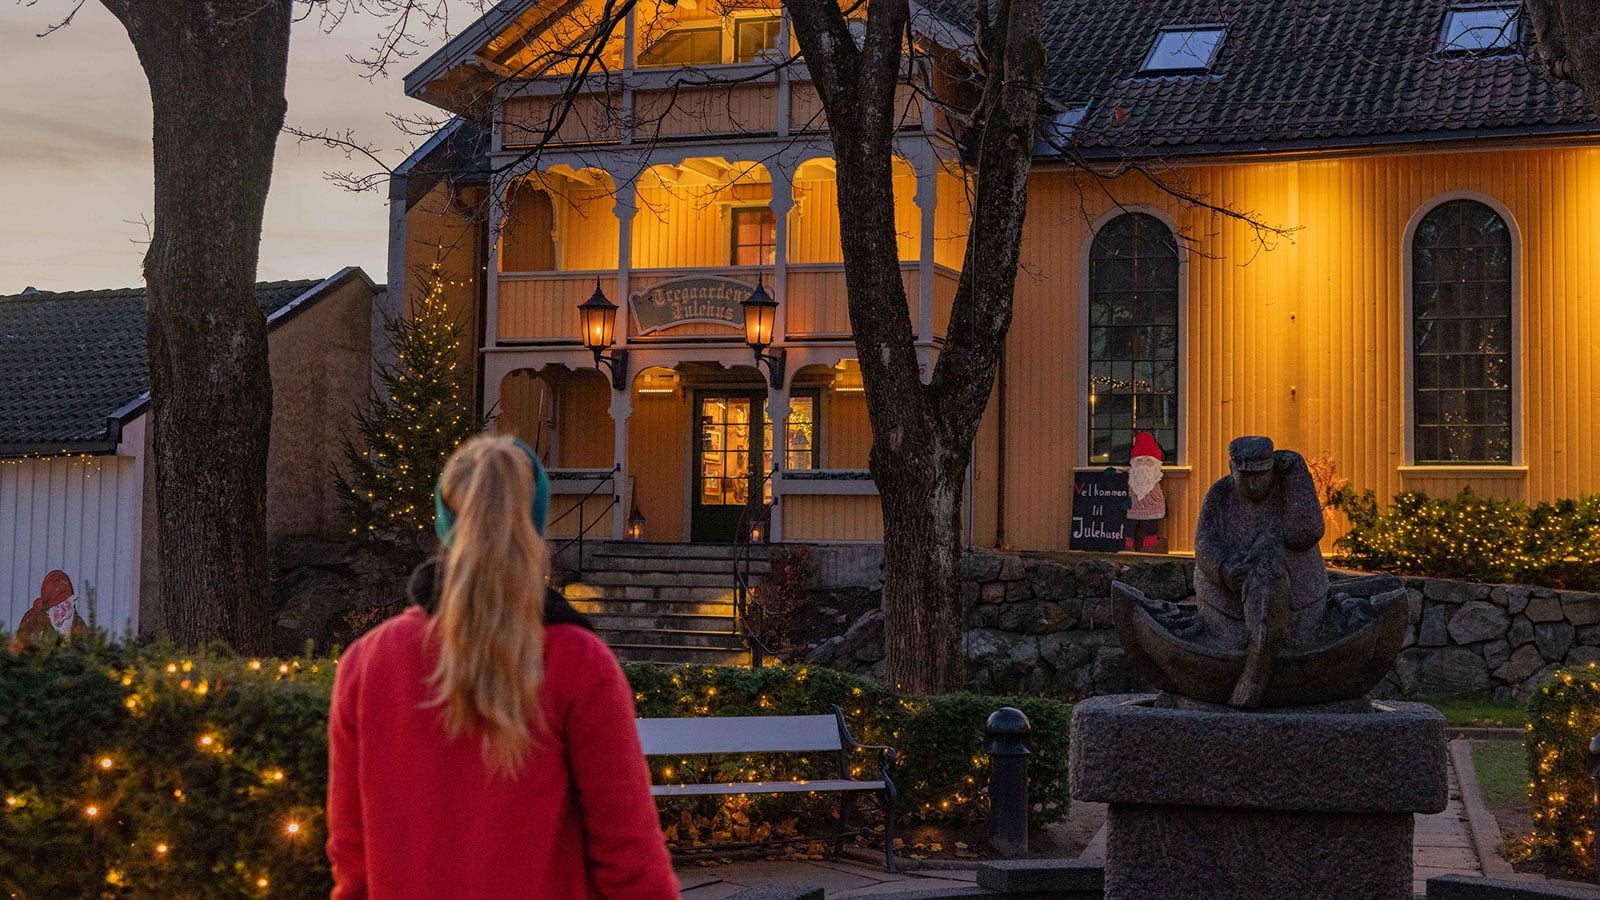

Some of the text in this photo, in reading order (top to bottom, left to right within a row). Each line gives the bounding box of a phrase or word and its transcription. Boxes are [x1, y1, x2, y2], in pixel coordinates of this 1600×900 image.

[671, 301, 734, 320] Julehus
[1074, 482, 1127, 497] Velkommen
[1092, 504, 1103, 516] til
[1072, 517, 1124, 539] Julehuset
